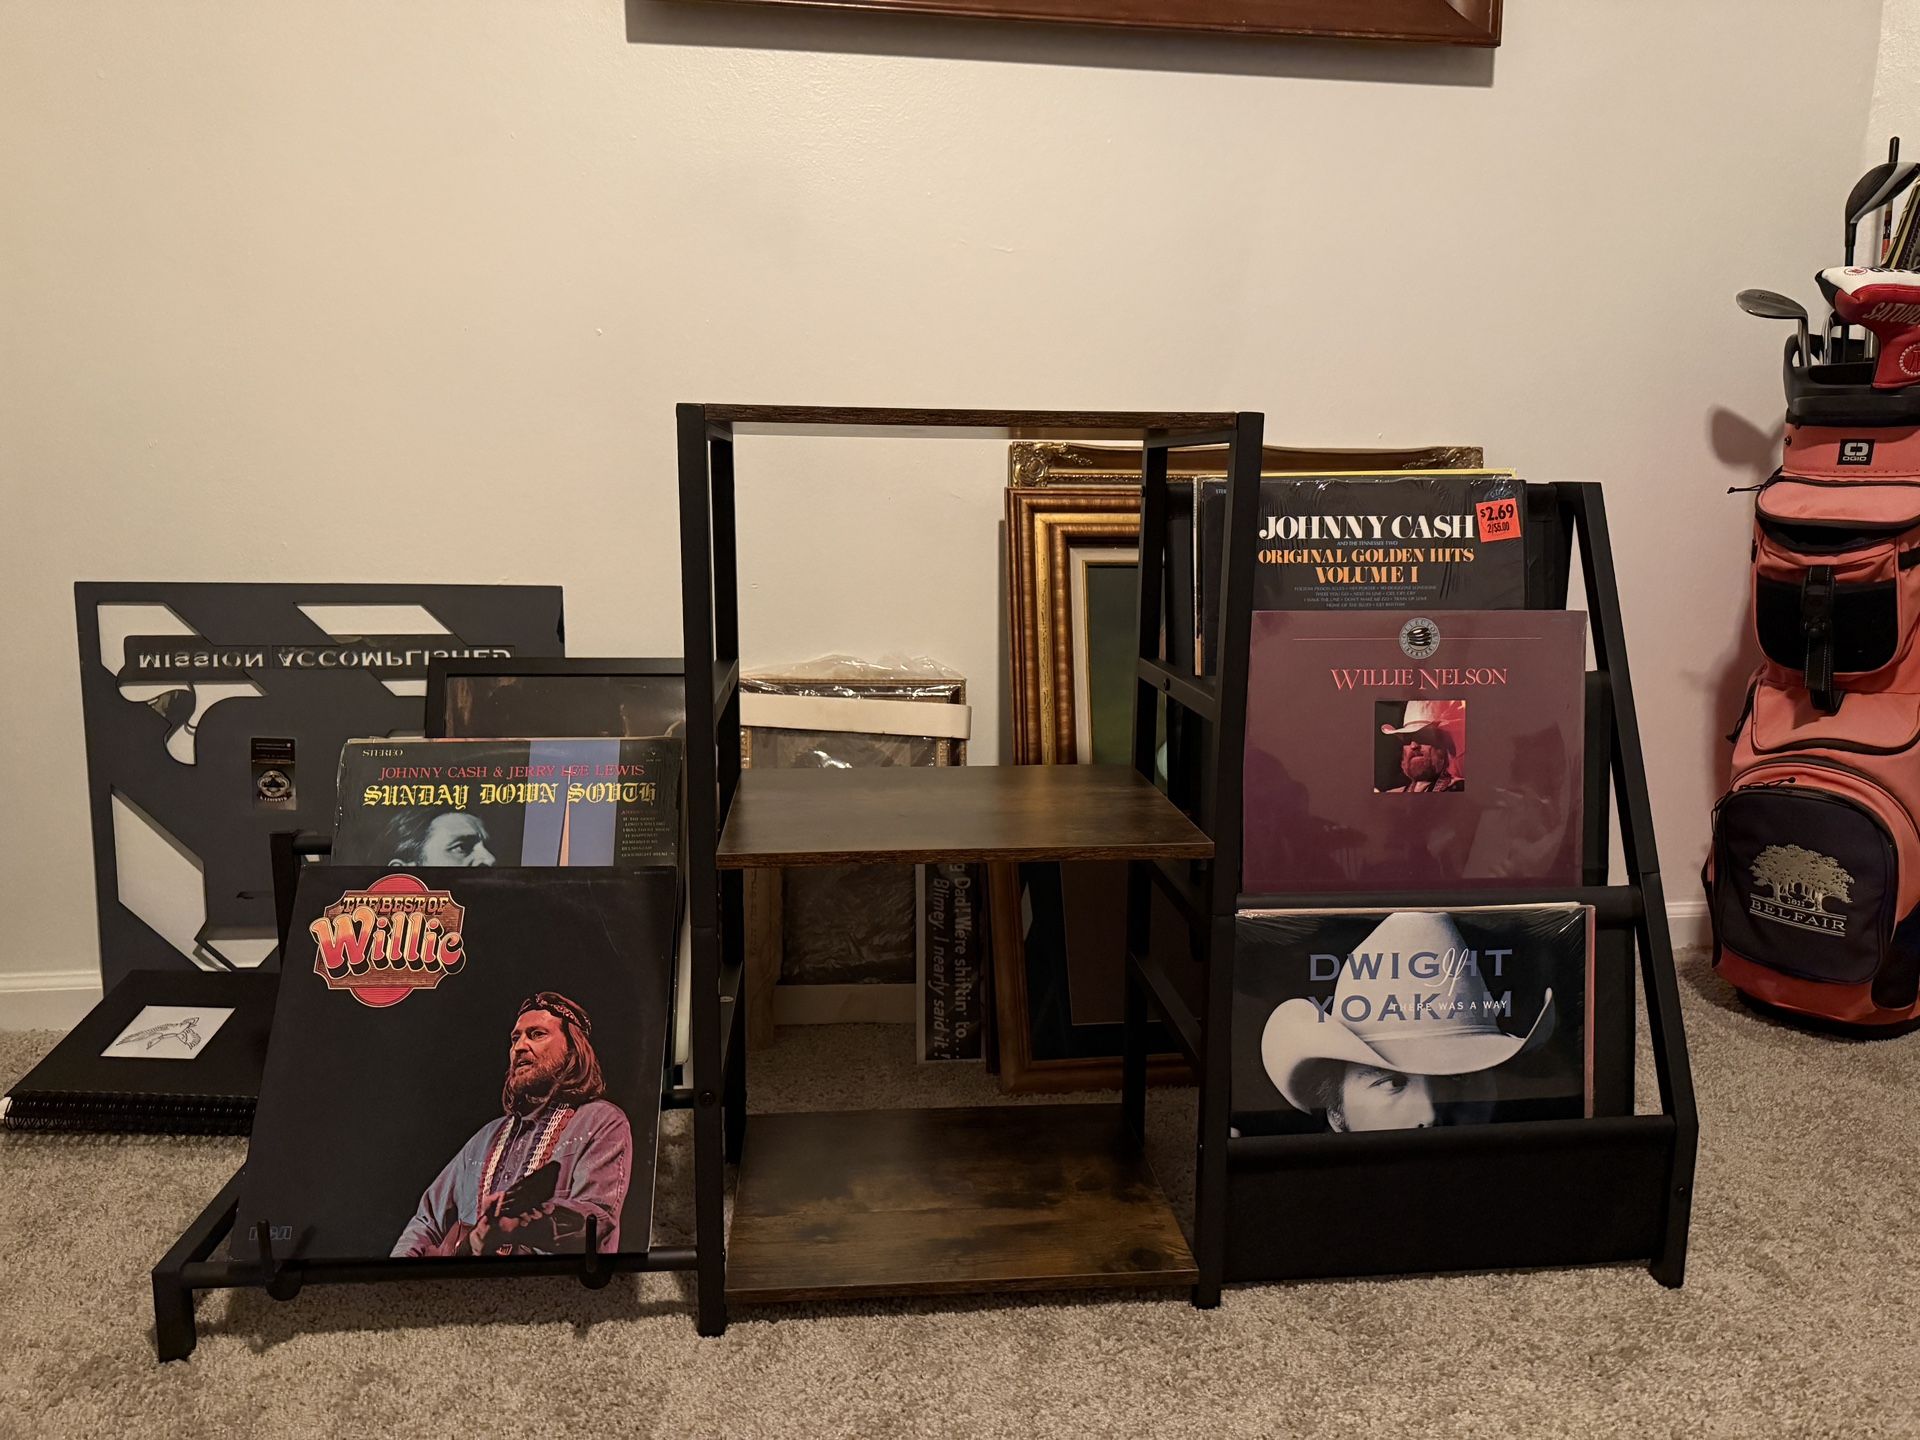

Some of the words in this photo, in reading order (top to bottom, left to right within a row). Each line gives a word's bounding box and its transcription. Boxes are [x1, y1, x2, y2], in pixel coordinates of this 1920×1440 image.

[1480, 503, 1514, 521] $2.69
[1258, 515, 1388, 540] JOHNNY
[1391, 514, 1474, 539] CASH
[1258, 548, 1347, 564] ORIGINAL
[1351, 547, 1425, 563] GOLDEN
[1430, 547, 1475, 563] HITS
[1315, 565, 1404, 584] VOLUME
[1330, 668, 1414, 690] WILLIE
[1418, 668, 1507, 690] NELSON
[362, 749, 403, 757] STEREO
[378, 766, 443, 781] JOHNNY
[447, 766, 487, 778] CASH
[493, 766, 503, 778] &
[506, 764, 556, 780] JERRY
[561, 764, 590, 778] LEE
[595, 764, 645, 777] LEWIS
[362, 784, 469, 811] SUNDAY
[480, 782, 559, 804] DOWN
[567, 782, 657, 807] SOUTH
[342, 896, 378, 913] THE
[381, 896, 425, 914] BEST
[427, 896, 449, 915] OF
[954, 877, 972, 913] Dad!
[1751, 900, 1846, 931] BELFAIR
[310, 906, 464, 974] Willie
[928, 945, 950, 996] nearly
[1309, 949, 1513, 981] DWIGHT
[933, 999, 950, 1030] said
[1308, 990, 1512, 1023] YOAKAM
[1390, 1002, 1432, 1012] THERE
[1438, 1001, 1464, 1011] WAS
[1469, 1000, 1477, 1010] A
[1483, 999, 1508, 1010] WAY
